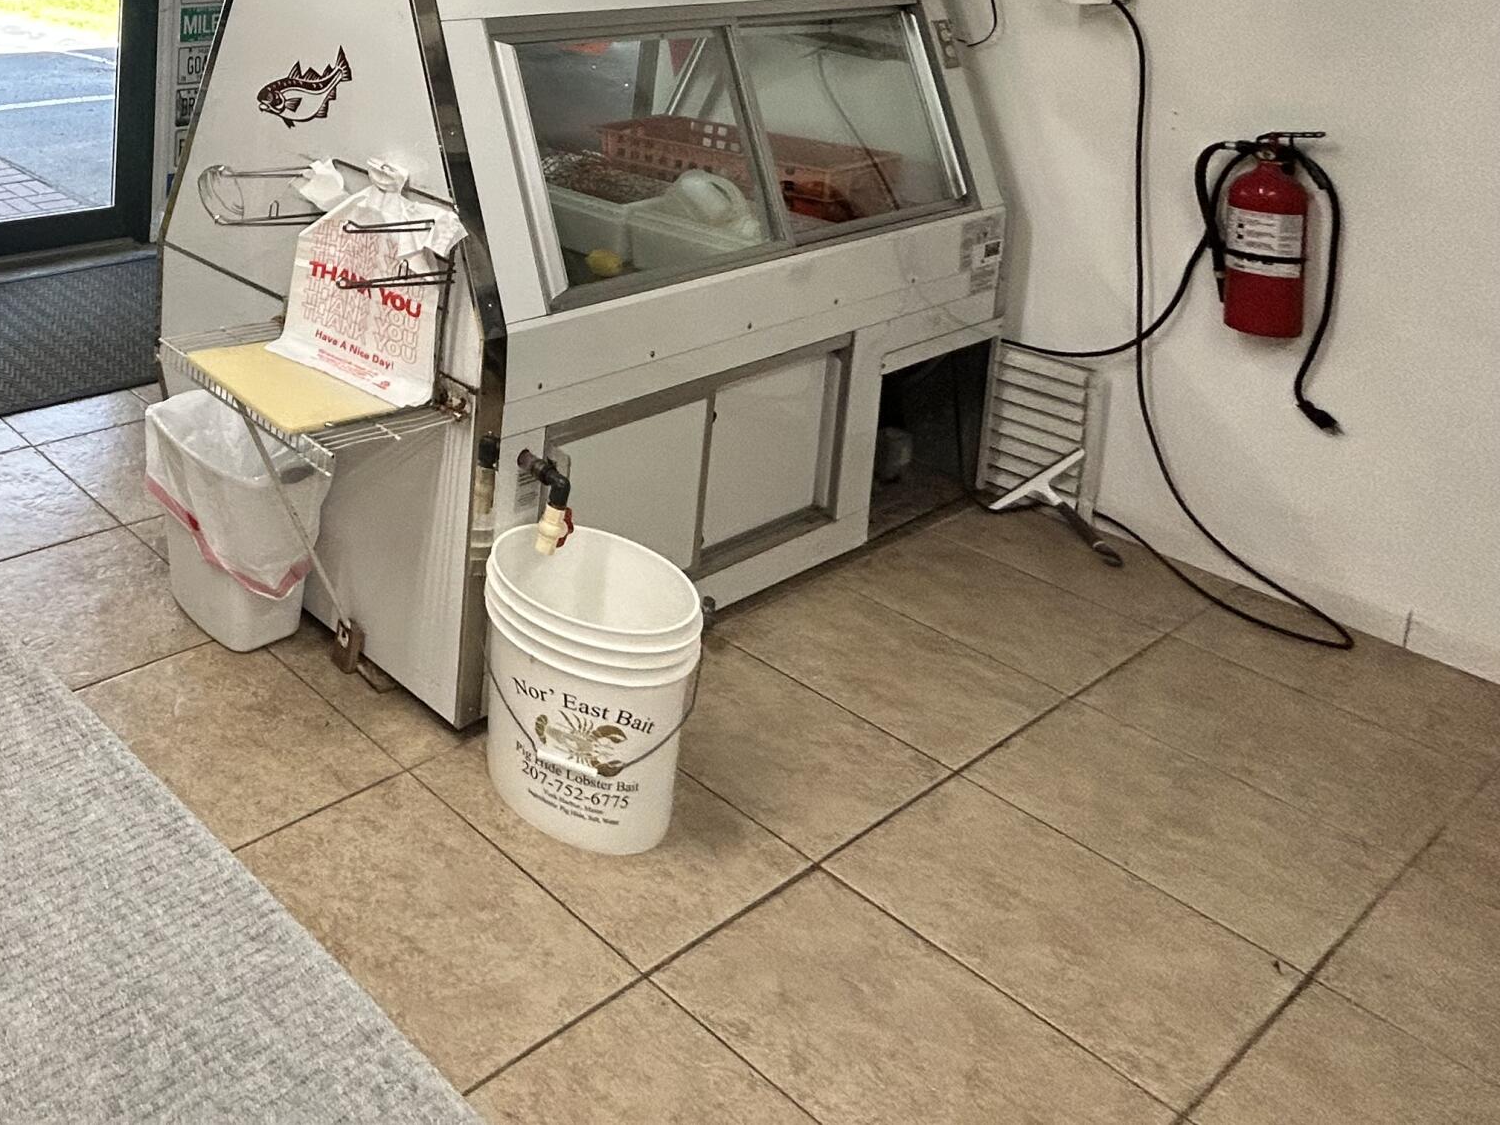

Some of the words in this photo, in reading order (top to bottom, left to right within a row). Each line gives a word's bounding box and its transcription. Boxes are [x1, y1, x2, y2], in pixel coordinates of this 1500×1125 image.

[379, 286, 422, 317] YOU
[315, 329, 338, 346] Have
[340, 341, 347, 351] A
[349, 344, 370, 360] Nice
[372, 354, 395, 370] Day!
[562, 692, 610, 721] East
[616, 709, 655, 735] Bait
[516, 740, 532, 762] Pig
[566, 769, 613, 792] Lobster
[617, 781, 639, 793] Bait
[522, 760, 629, 809] 207-752-6775
